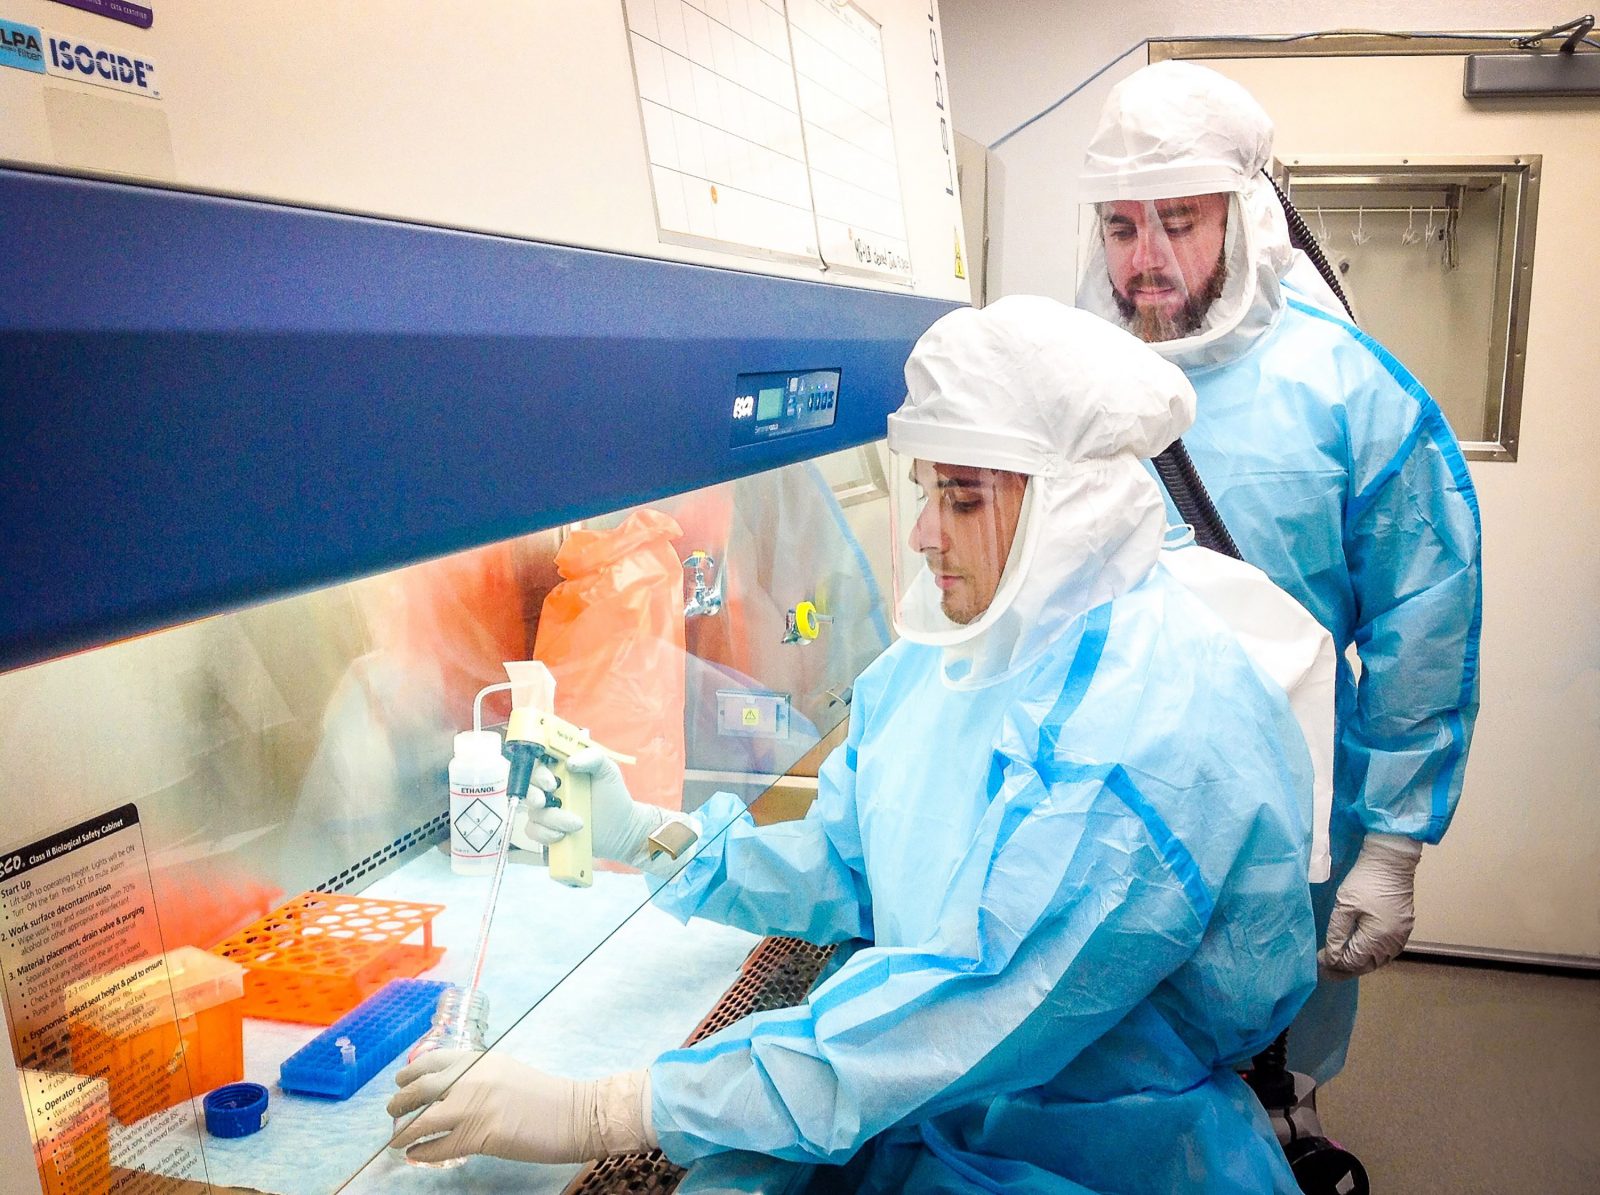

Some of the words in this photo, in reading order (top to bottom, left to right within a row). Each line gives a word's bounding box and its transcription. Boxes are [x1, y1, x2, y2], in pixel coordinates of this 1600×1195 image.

[460, 786, 495, 795] ETHANOL
[28, 852, 46, 864] Class
[51, 835, 81, 854] Biological
[81, 828, 100, 841] Safety
[100, 817, 123, 833] Cabinet
[0, 883, 19, 898] Start
[20, 880, 31, 889] Up
[42, 874, 70, 890] operating
[125, 843, 134, 853] ON
[8, 922, 28, 937] Work
[29, 910, 55, 927] surface
[55, 883, 111, 914] decontamination
[17, 932, 35, 944] Wipe
[35, 924, 49, 936] work
[50, 919, 62, 929] tray
[63, 911, 74, 922] and
[75, 903, 94, 916] interior
[95, 895, 109, 906] walls
[122, 881, 135, 893] 70%
[26, 900, 37, 910] ON
[37, 897, 47, 905] the
[61, 883, 75, 894] Press
[76, 877, 87, 887] SET
[8, 971, 15, 979] 3.
[16, 955, 45, 975] Material
[81, 930, 98, 943] drain
[98, 921, 115, 934] valve
[115, 916, 120, 925] &
[121, 906, 145, 924] purging
[20, 938, 42, 955] alcohol
[50, 927, 66, 939] other
[66, 911, 98, 931] appropriate
[25, 966, 51, 984] Separate
[51, 958, 66, 970] clean
[67, 950, 78, 961] and
[79, 931, 114, 955] contaminated
[27, 986, 36, 994] Do
[37, 978, 47, 989] not
[49, 972, 59, 984] put
[60, 968, 70, 977] any
[88, 954, 95, 962] on
[96, 949, 105, 958] the
[30, 991, 47, 1006] Check
[50, 983, 62, 995] that
[67, 986, 77, 997] 2-3
[78, 981, 89, 991] min
[68, 1000, 87, 1017] adjust
[88, 992, 100, 1006] seat
[100, 981, 120, 998] height
[120, 978, 125, 987] &
[126, 971, 137, 985] pad
[137, 969, 144, 977] to
[144, 958, 162, 973] ensure
[44, 1086, 75, 1110] Operator
[76, 1064, 110, 1091] guidelines
[107, 1179, 119, 1193] and
[120, 1163, 145, 1185] purging
